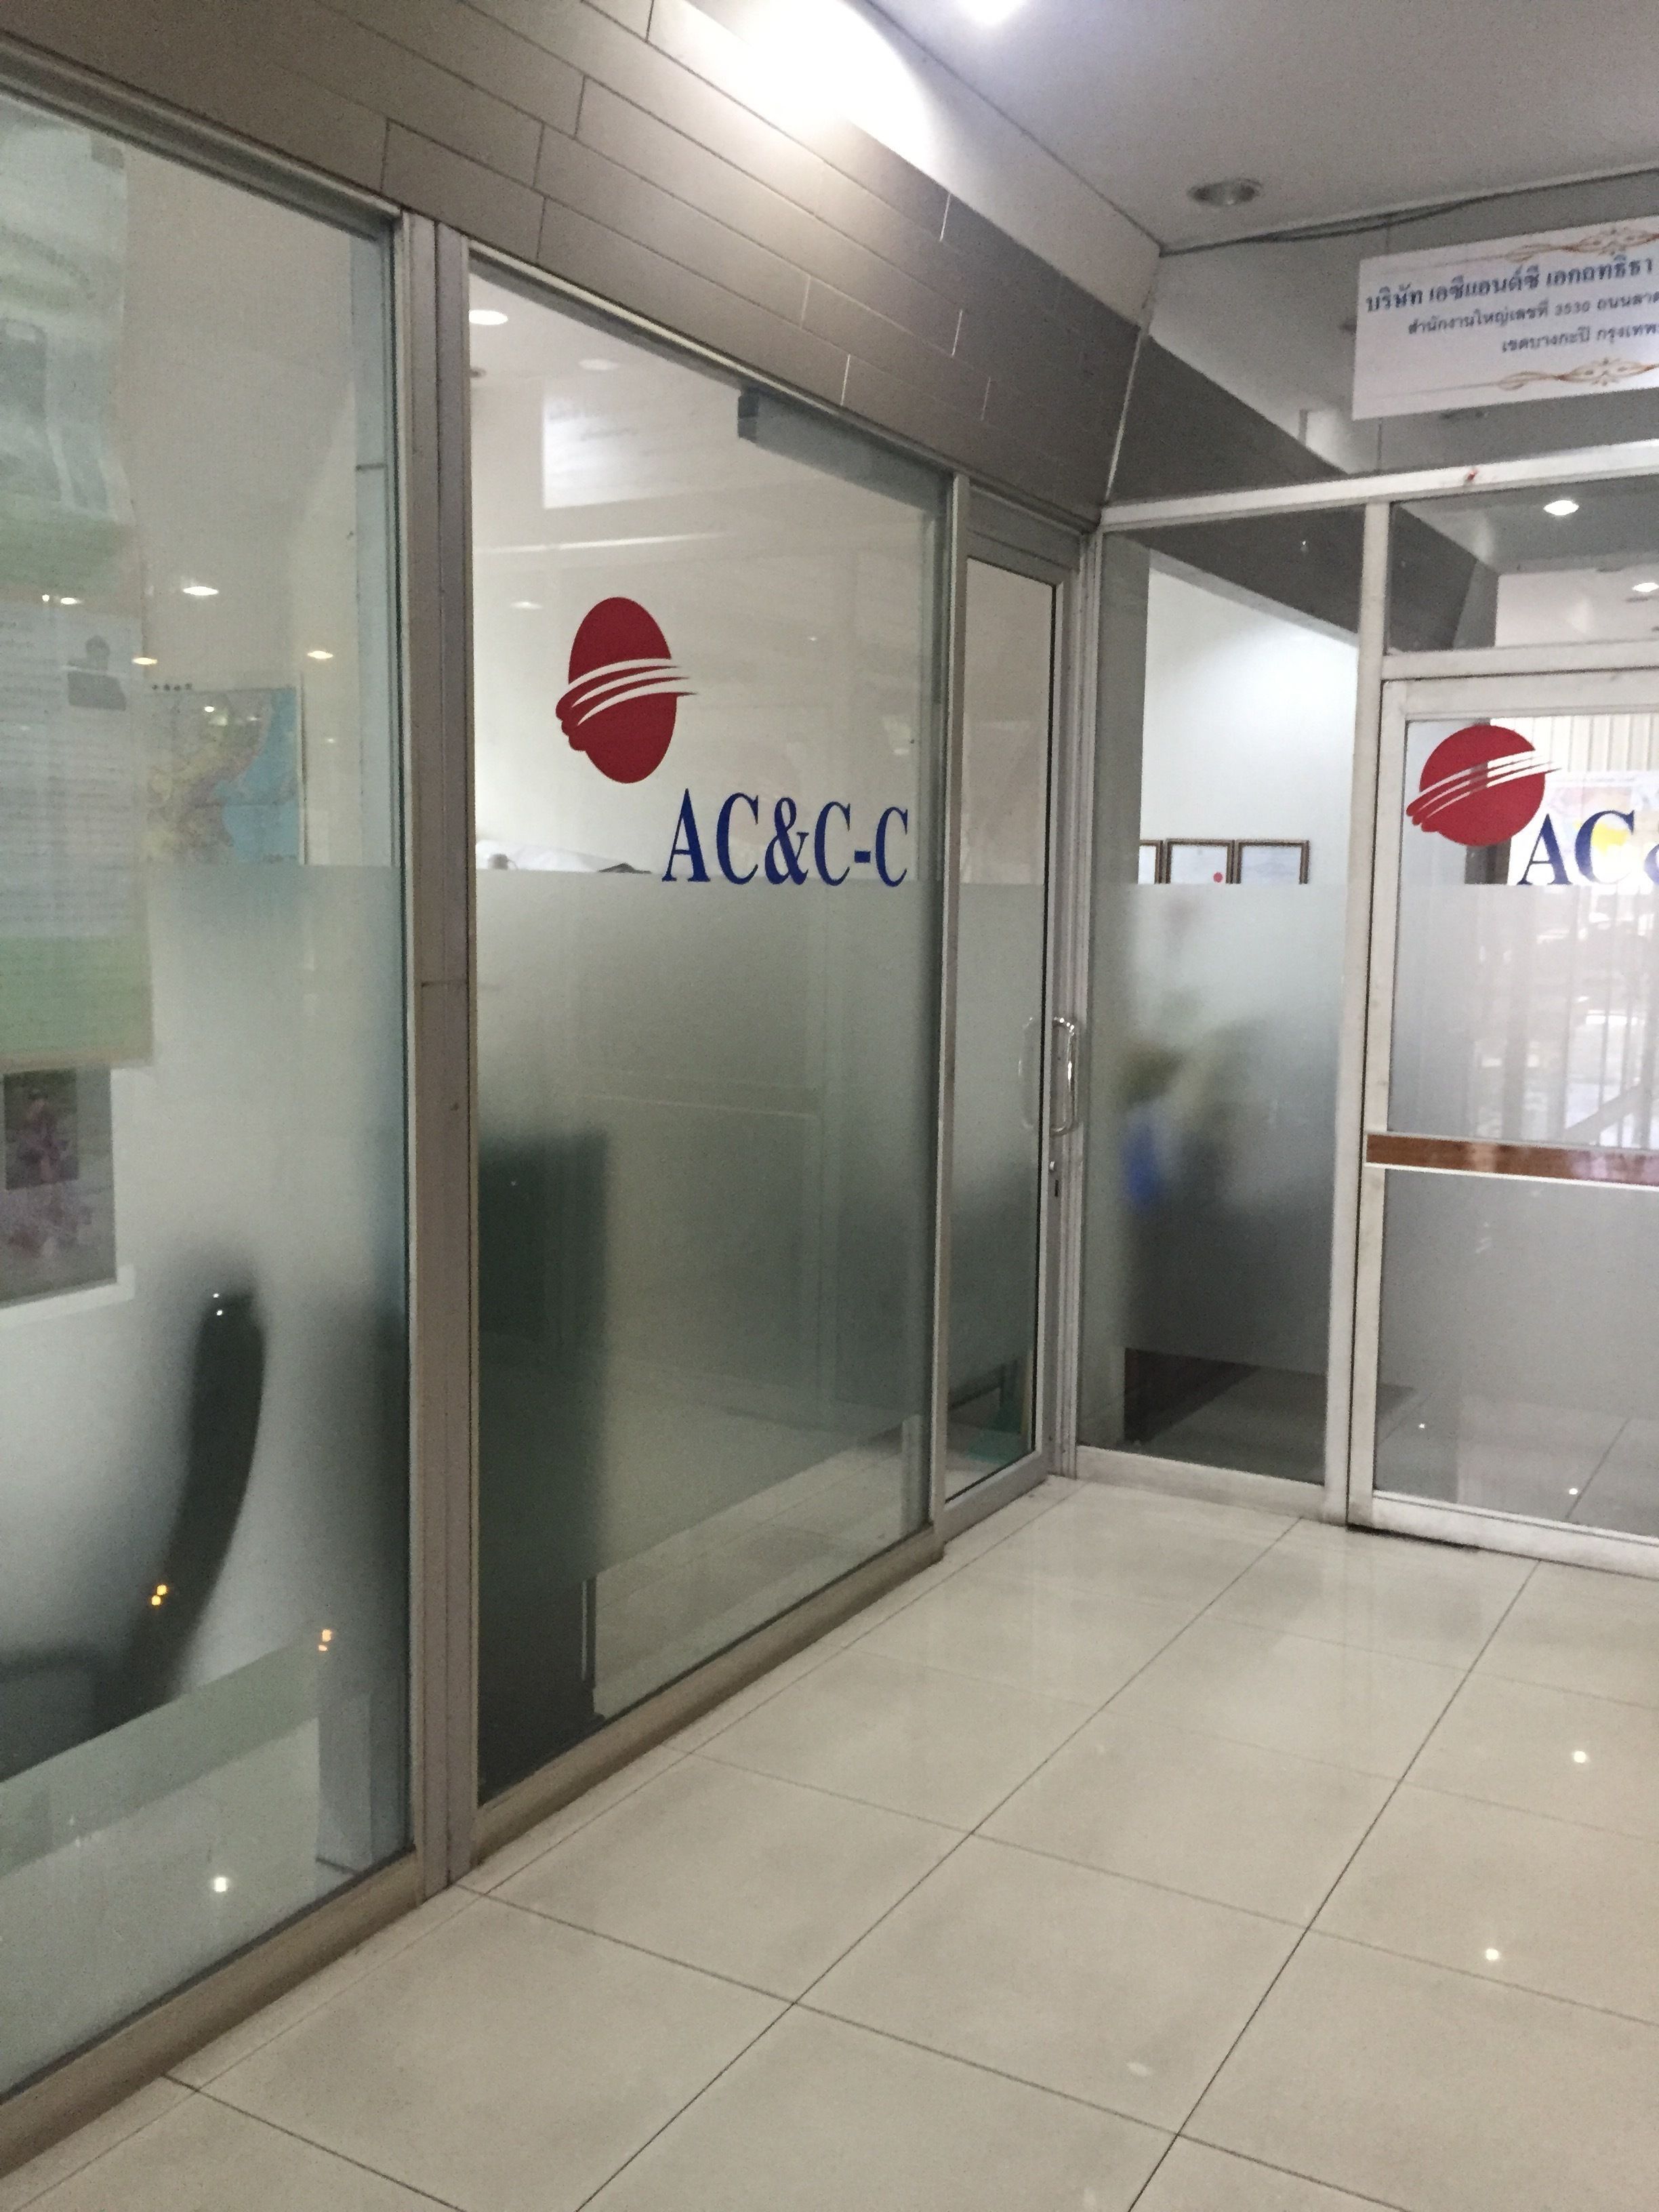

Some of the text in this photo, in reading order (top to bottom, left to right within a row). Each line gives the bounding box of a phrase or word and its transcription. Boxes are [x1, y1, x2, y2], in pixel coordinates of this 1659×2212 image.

[1366, 282, 1423, 312] บริษัท
[1597, 323, 1659, 344] กรุงเทพ
[661, 787, 909, 888] AC&C-C
[1515, 809, 1659, 886] AC
